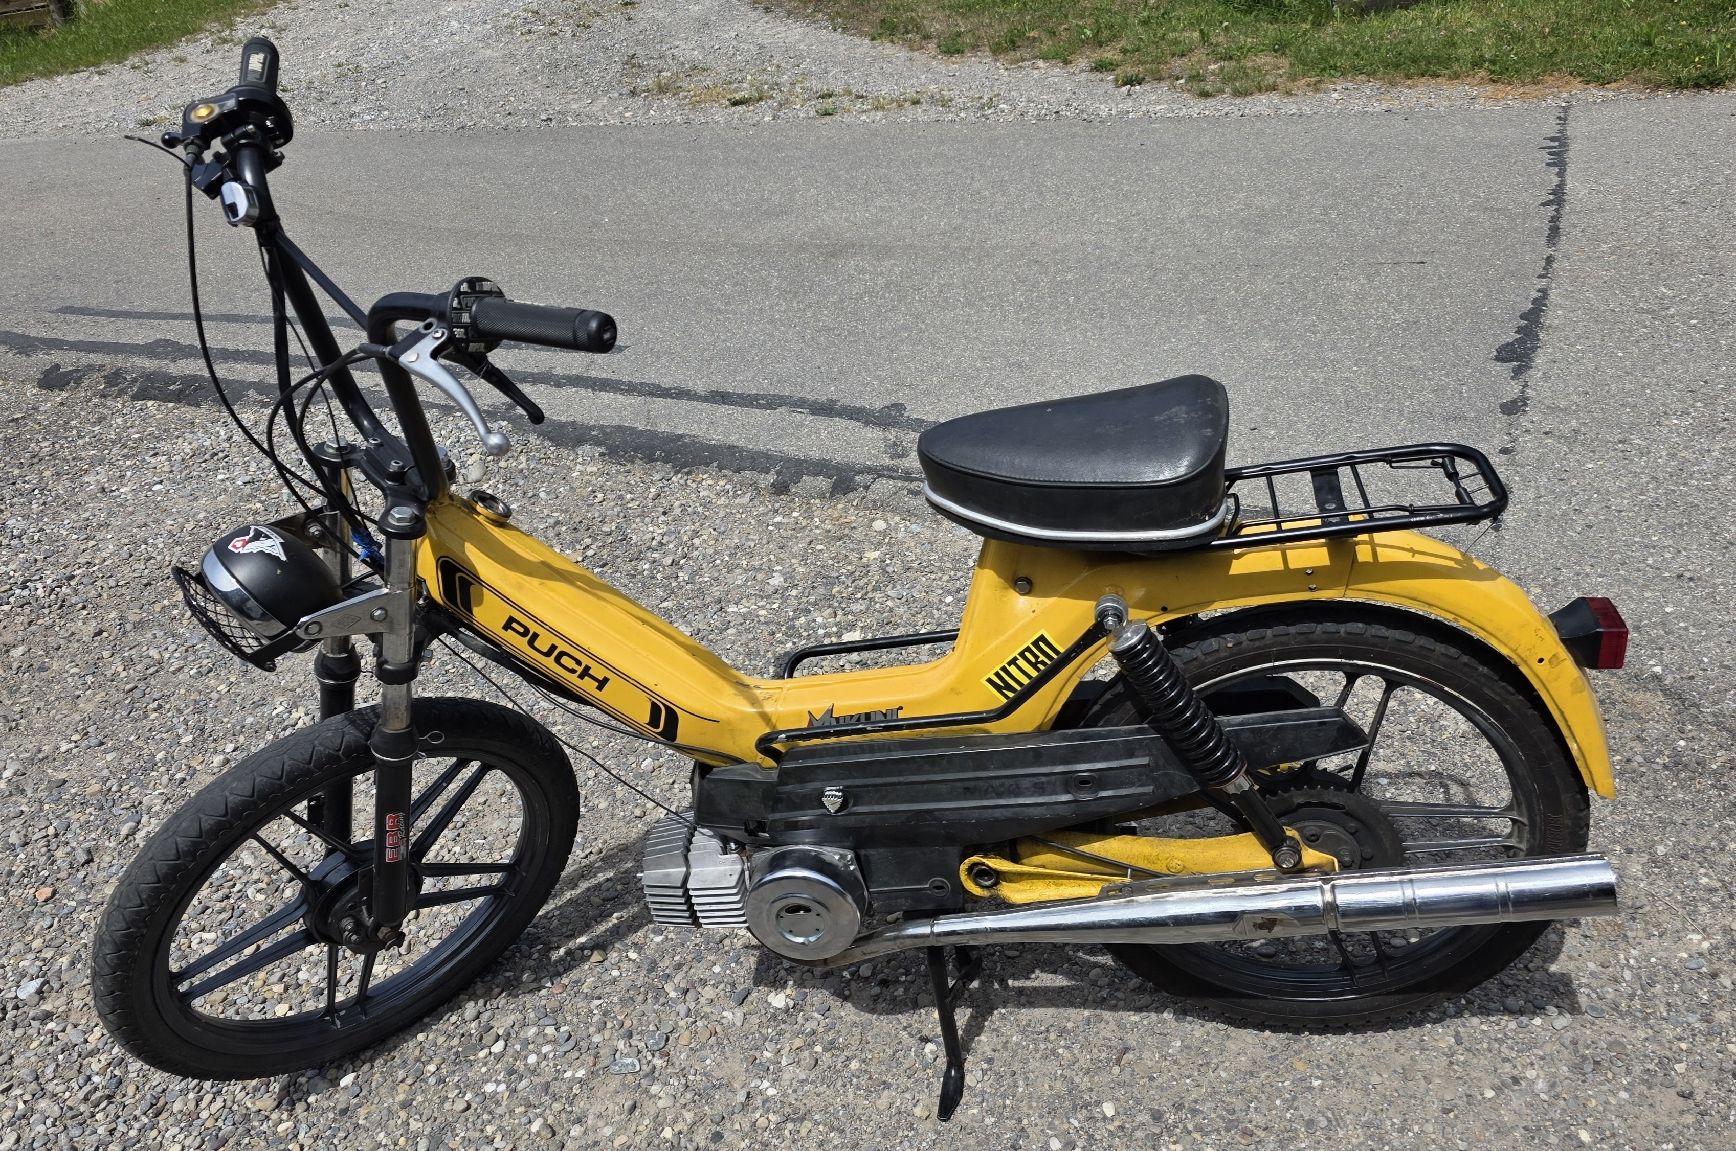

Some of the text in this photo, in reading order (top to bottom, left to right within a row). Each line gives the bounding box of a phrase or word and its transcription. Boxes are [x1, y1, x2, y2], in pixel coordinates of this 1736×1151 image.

[502, 615, 610, 692] PUCH
[985, 634, 1062, 700] NITRO
[385, 813, 400, 862] EBR
